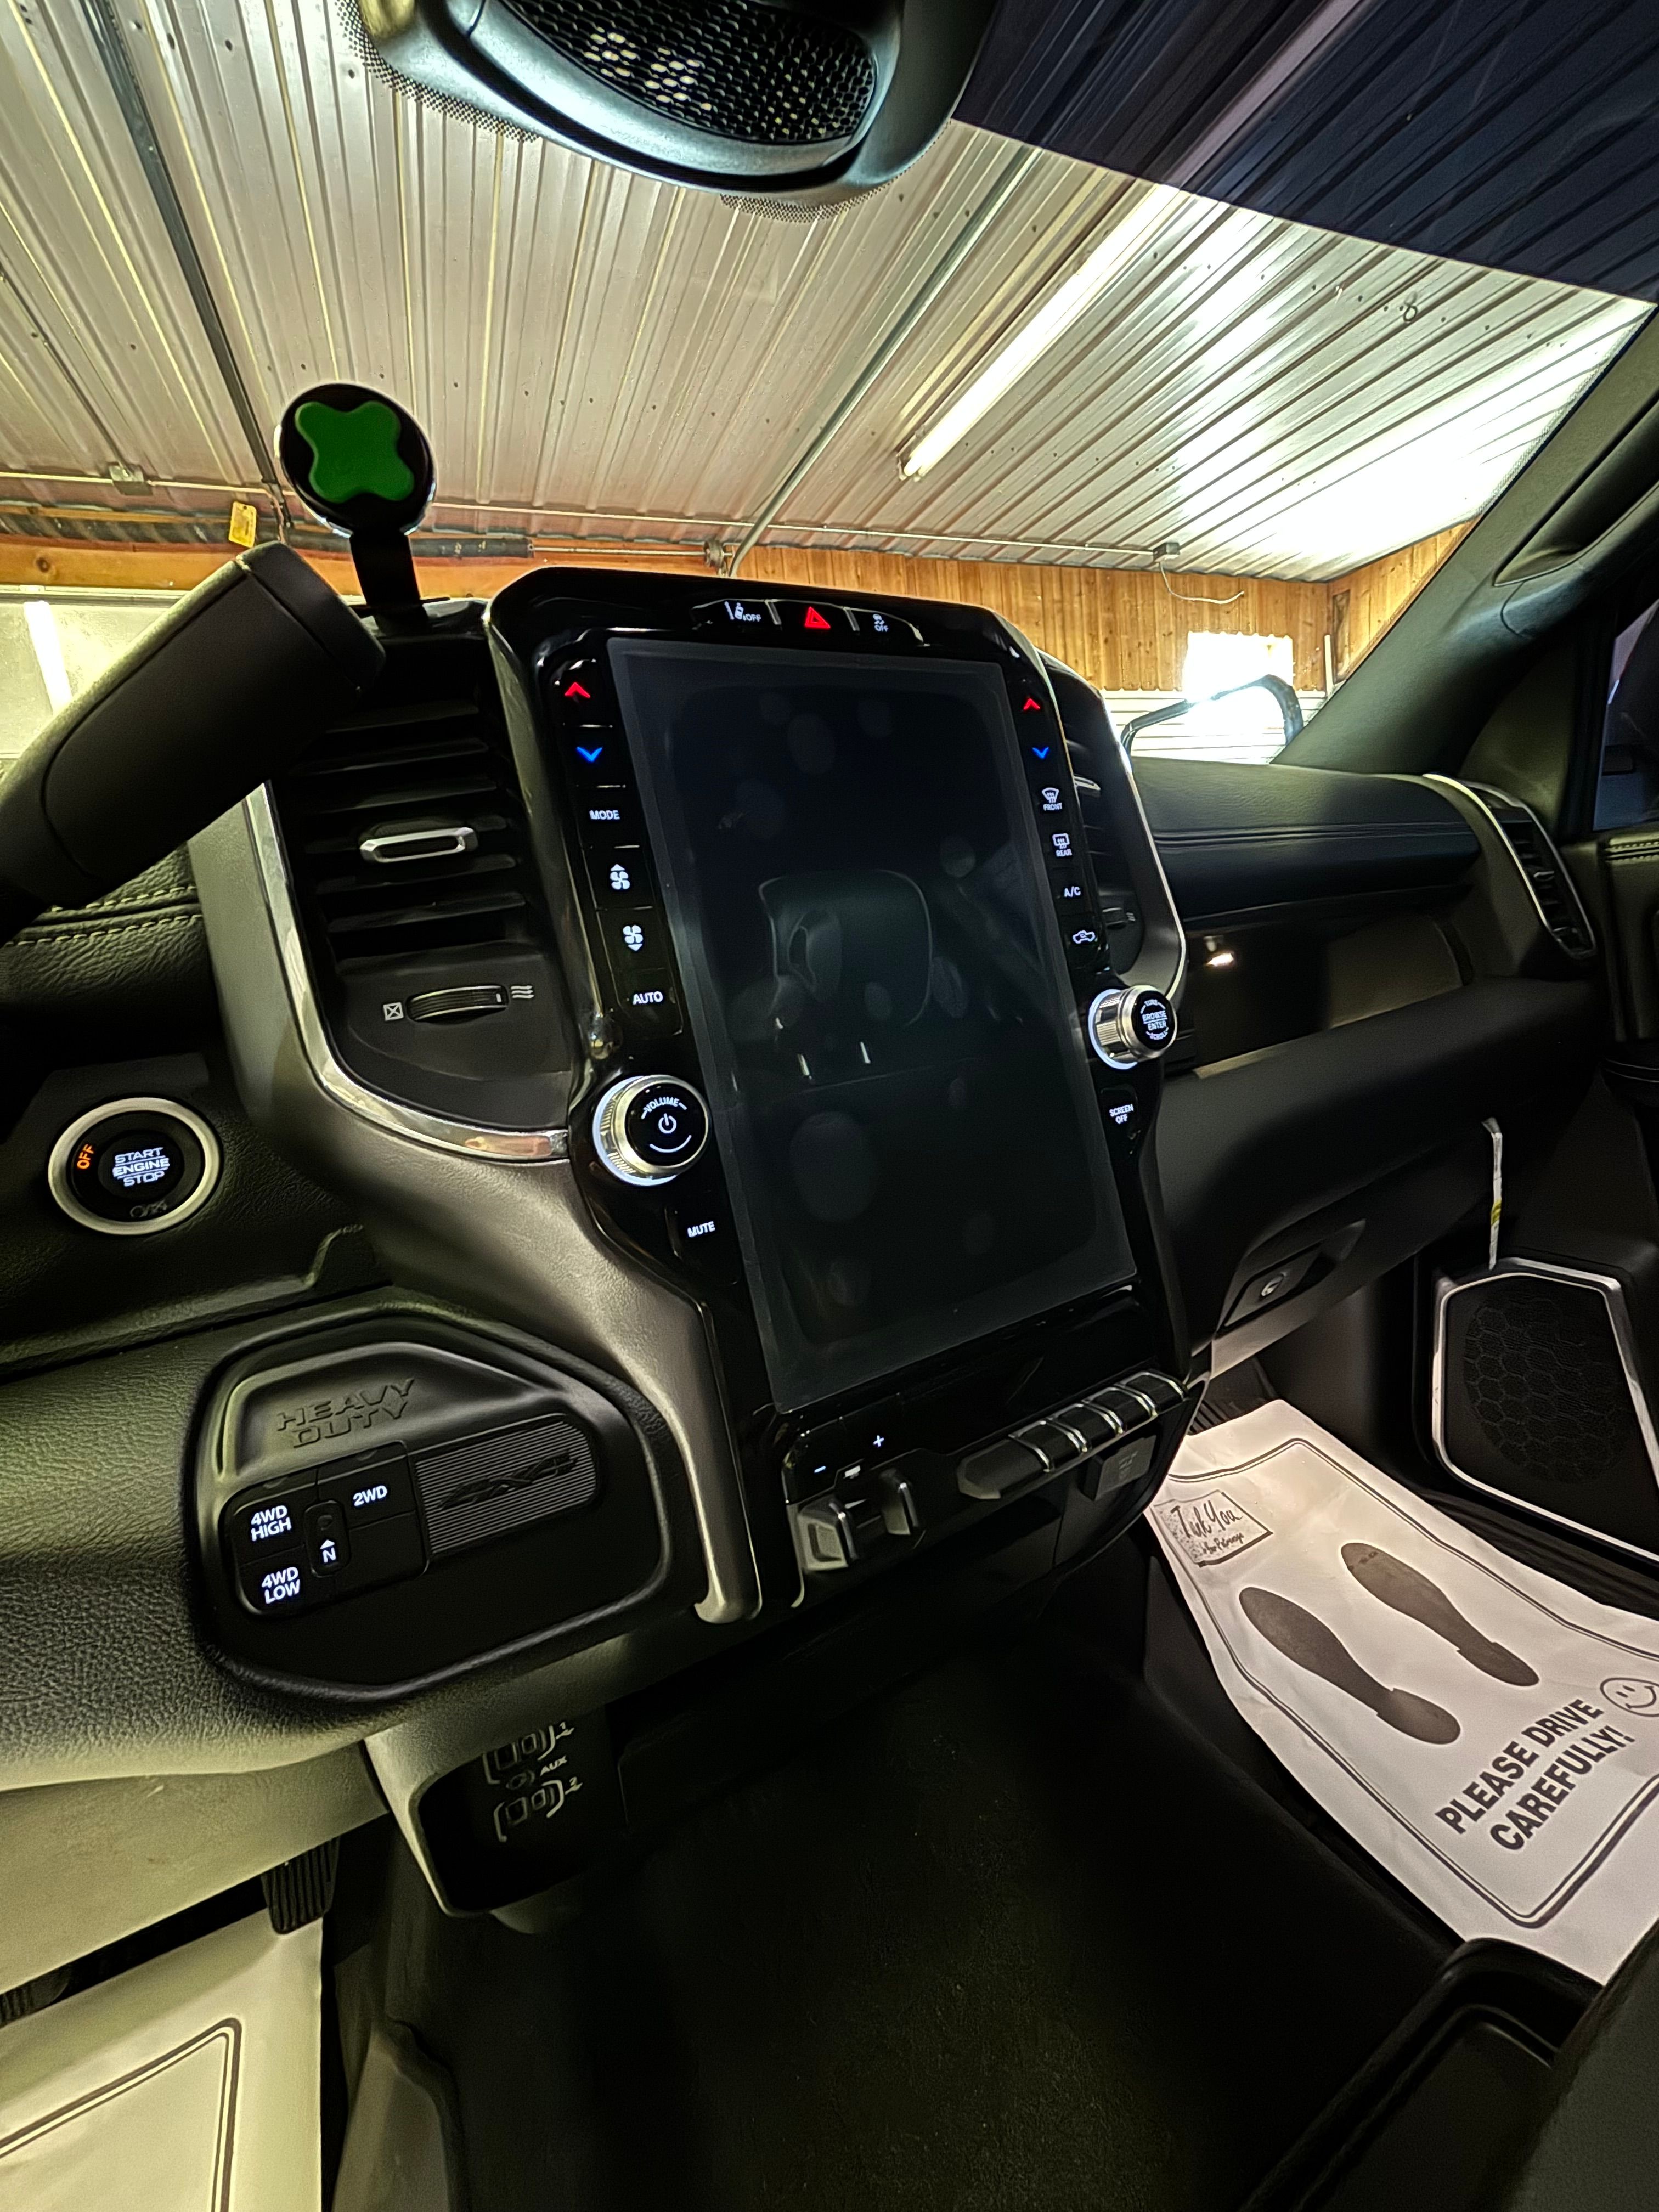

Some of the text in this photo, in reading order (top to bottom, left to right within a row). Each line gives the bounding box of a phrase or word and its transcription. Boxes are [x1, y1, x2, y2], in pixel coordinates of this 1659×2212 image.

[747, 614, 761, 622] OFF
[589, 810, 620, 820] MODE
[1043, 803, 1063, 811] FRONT
[1056, 849, 1073, 857] REAR
[1064, 886, 1081, 898] A/C
[633, 991, 663, 1005] AUTO
[1142, 1010, 1167, 1022] BROWSE
[1148, 1020, 1167, 1031] ENTER
[643, 1097, 680, 1113] VOLUME
[1109, 1103, 1134, 1117] SCREEN
[1115, 1114, 1128, 1124] OFF
[76, 1144, 94, 1170] OFF
[115, 1147, 164, 1164] START
[112, 1158, 170, 1177] ENGINE
[123, 1171, 165, 1187] STOP
[687, 1221, 715, 1237] MUTE
[277, 1379, 415, 1431] HEAVY
[291, 1401, 408, 1449] DUTY
[353, 1485, 388, 1507] 2WD
[251, 1505, 288, 1526] 4WD
[1203, 1500, 1243, 1531] You
[251, 1517, 292, 1542] HIGH
[323, 1547, 336, 1563] N
[261, 1567, 299, 1589] 4WD
[264, 1579, 300, 1604] LOW
[540, 1755, 568, 1777] AUX
[1435, 1699, 1605, 1835] PLEASE DRIVE
[1490, 1725, 1635, 1850] CAREFULLY!
